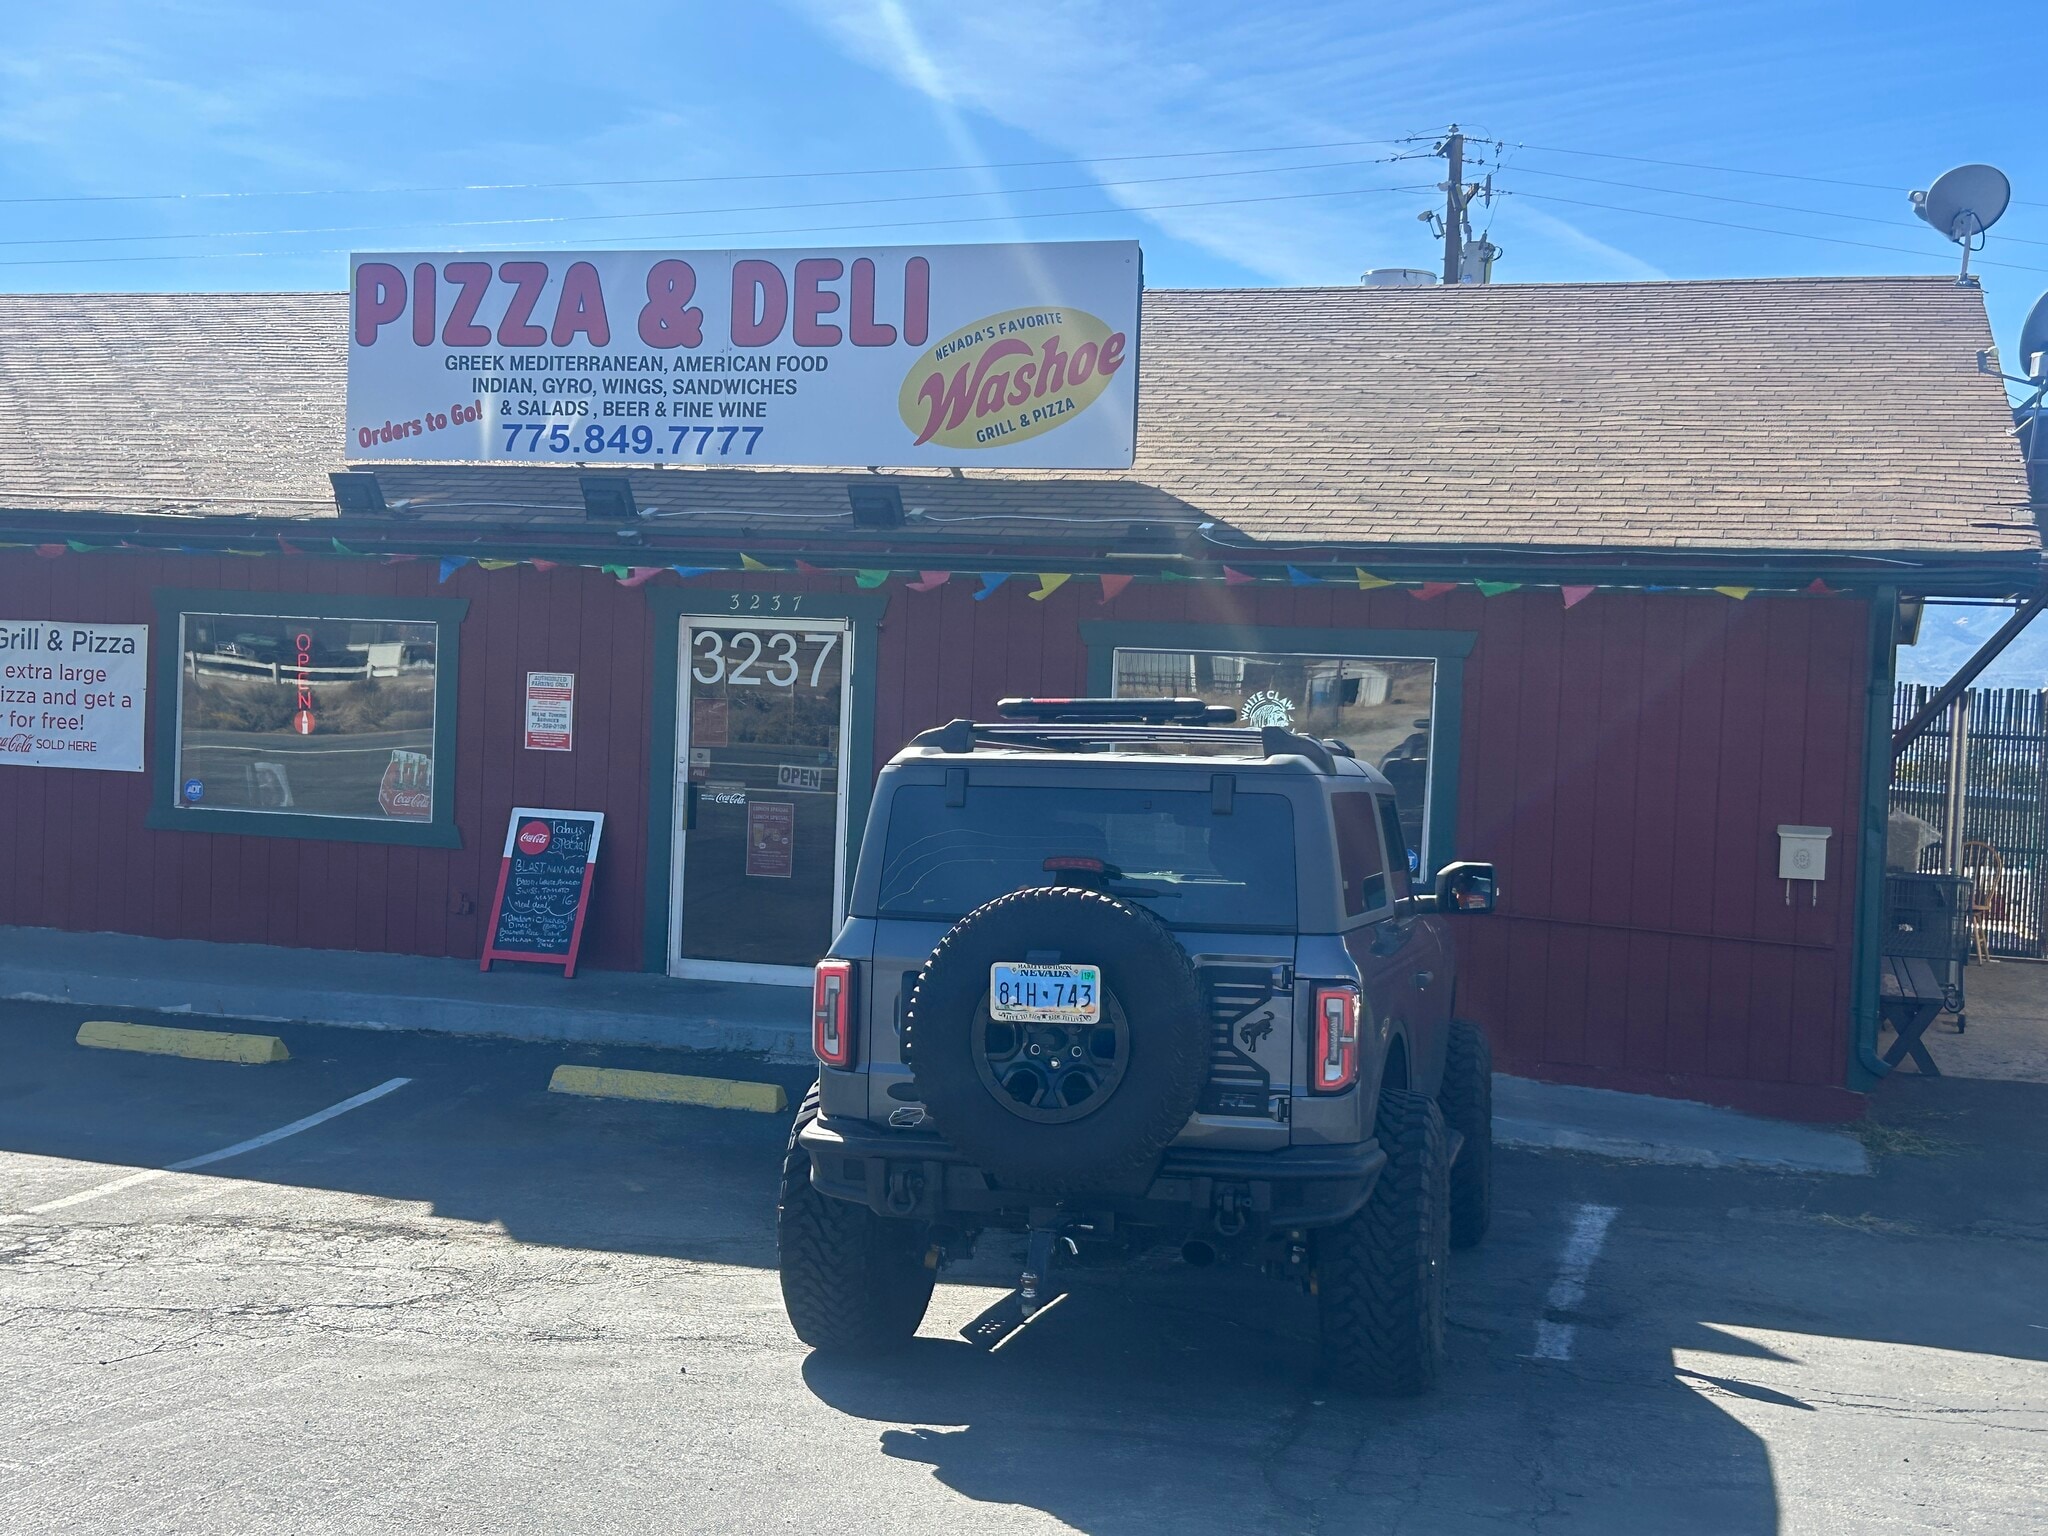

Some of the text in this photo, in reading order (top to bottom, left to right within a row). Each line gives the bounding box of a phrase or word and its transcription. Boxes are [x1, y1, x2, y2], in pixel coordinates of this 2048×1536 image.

[355, 256, 930, 349] PIZZA & DELI
[935, 312, 1063, 361] NEVADA'S FAVORITE
[445, 354, 829, 375] GREEK MEDITERRANEAN, AMERICAN FOOD
[472, 377, 798, 398] INDIAN, GYRO, WINGS, SANDWICHES
[913, 332, 1126, 447] Washoe
[500, 401, 513, 417] &
[603, 401, 650, 418] BEER
[655, 402, 667, 418] &
[673, 402, 714, 418] FINE
[719, 401, 767, 418] WINE
[976, 397, 1076, 443] GRILL & PIZZA
[358, 400, 483, 448] Orders to Go!
[502, 423, 765, 456] 775.849.7777
[729, 594, 802, 611] 3237
[47, 629, 63, 651] &
[72, 630, 135, 654] Pizza
[692, 630, 838, 687] 3237
[5, 663, 107, 685] extra large
[296, 633, 312, 709] OPEN
[0, 686, 132, 709] izza and get a
[1240, 690, 1295, 721] WHITE CLAW
[9, 710, 36, 728] for
[42, 711, 84, 730] free!
[36, 738, 65, 750] SOLD
[68, 741, 97, 752] HERE
[780, 767, 820, 787] OPEN
[187, 785, 202, 794] ADT
[1020, 969, 1071, 978] NEVADA
